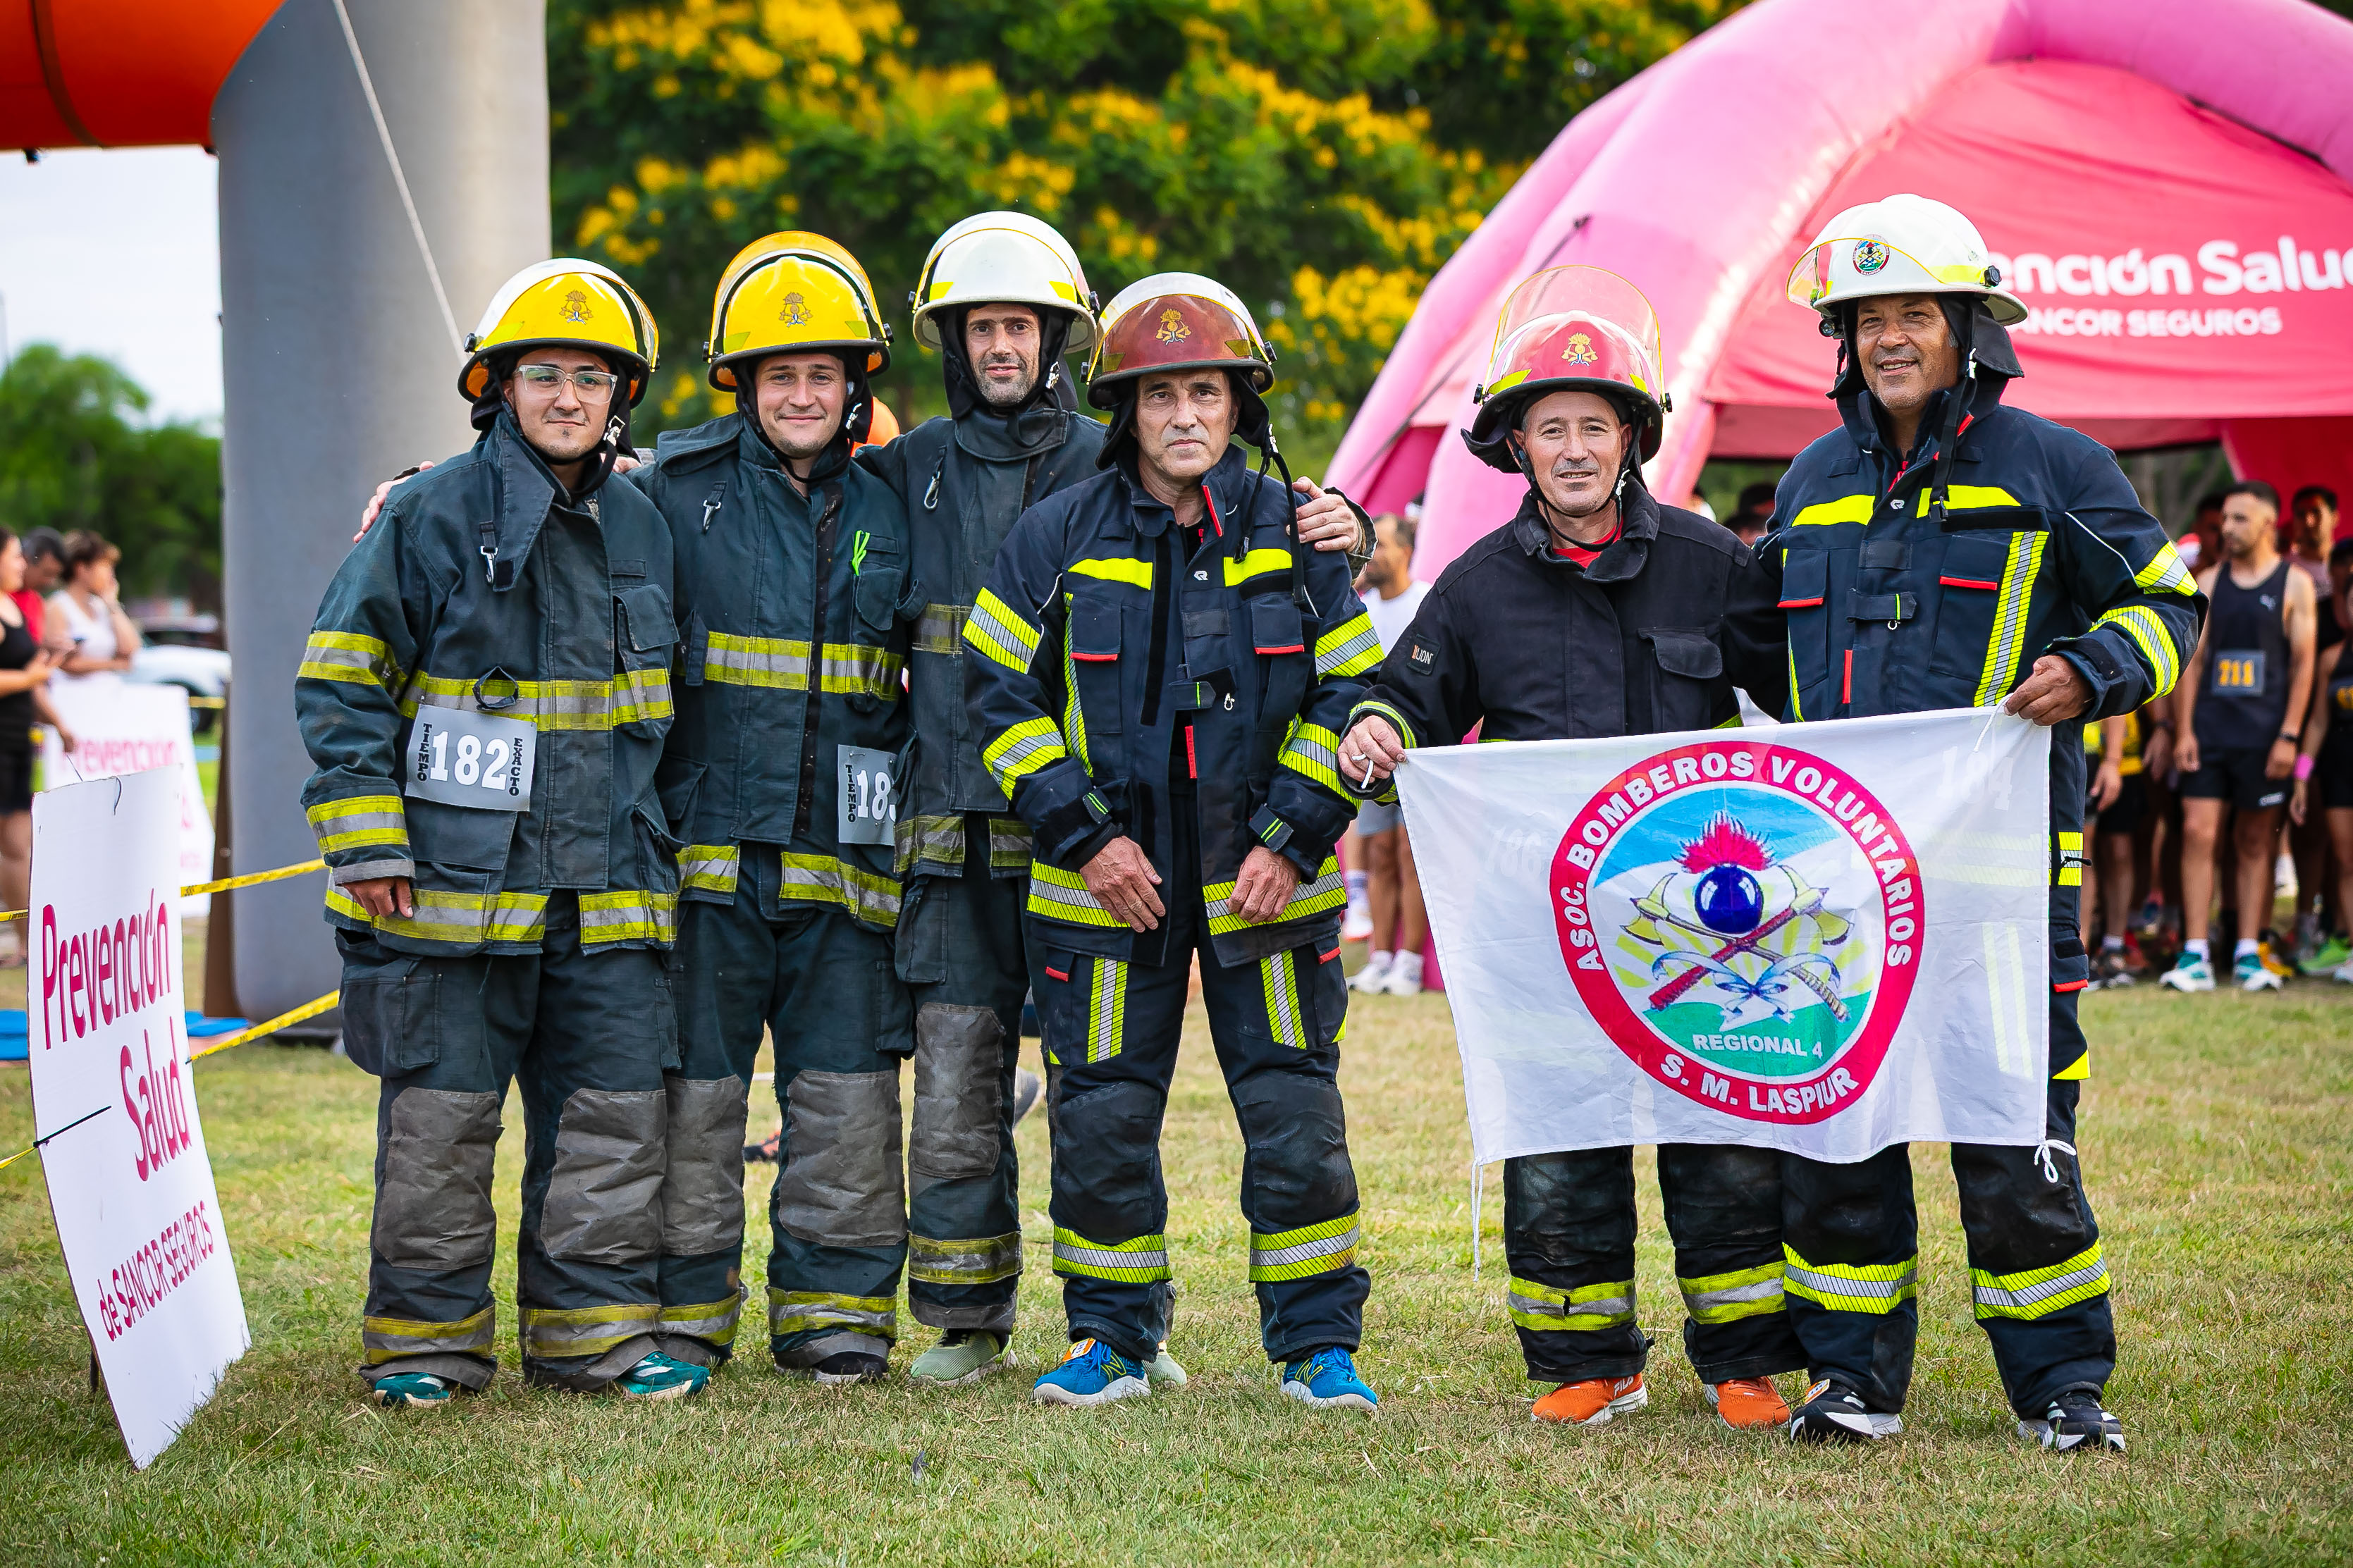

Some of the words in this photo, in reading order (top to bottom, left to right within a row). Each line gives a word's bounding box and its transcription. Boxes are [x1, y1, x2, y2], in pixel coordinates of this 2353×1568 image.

[1988, 249, 2193, 297] ención
[2197, 235, 2353, 296] Salu
[2005, 306, 2122, 338] ANCOR
[2127, 305, 2283, 338] SEGUROS
[1415, 646, 1434, 665] LION
[417, 722, 433, 782] TIEMPO
[429, 730, 510, 791] 182
[508, 737, 524, 796] EXACTO
[844, 764, 857, 823] TIEMPO
[1566, 751, 1755, 871] BOMBEROS
[1771, 755, 1916, 968] VOLUNTARIOS
[1559, 881, 1604, 971] ASOC.
[42, 887, 171, 1051] Prevención
[1692, 1034, 1808, 1057] REGIONAL
[1812, 1041, 1824, 1059] 4
[120, 1016, 192, 1182] Salud
[1660, 1054, 1690, 1087] S.
[1700, 1071, 1739, 1106] M.
[1748, 1066, 1860, 1115] LASPIUR
[97, 1278, 123, 1342] de
[112, 1239, 172, 1328] SANCOR
[161, 1199, 214, 1288] SEGUROS
[1614, 1376, 1635, 1397] FILA
